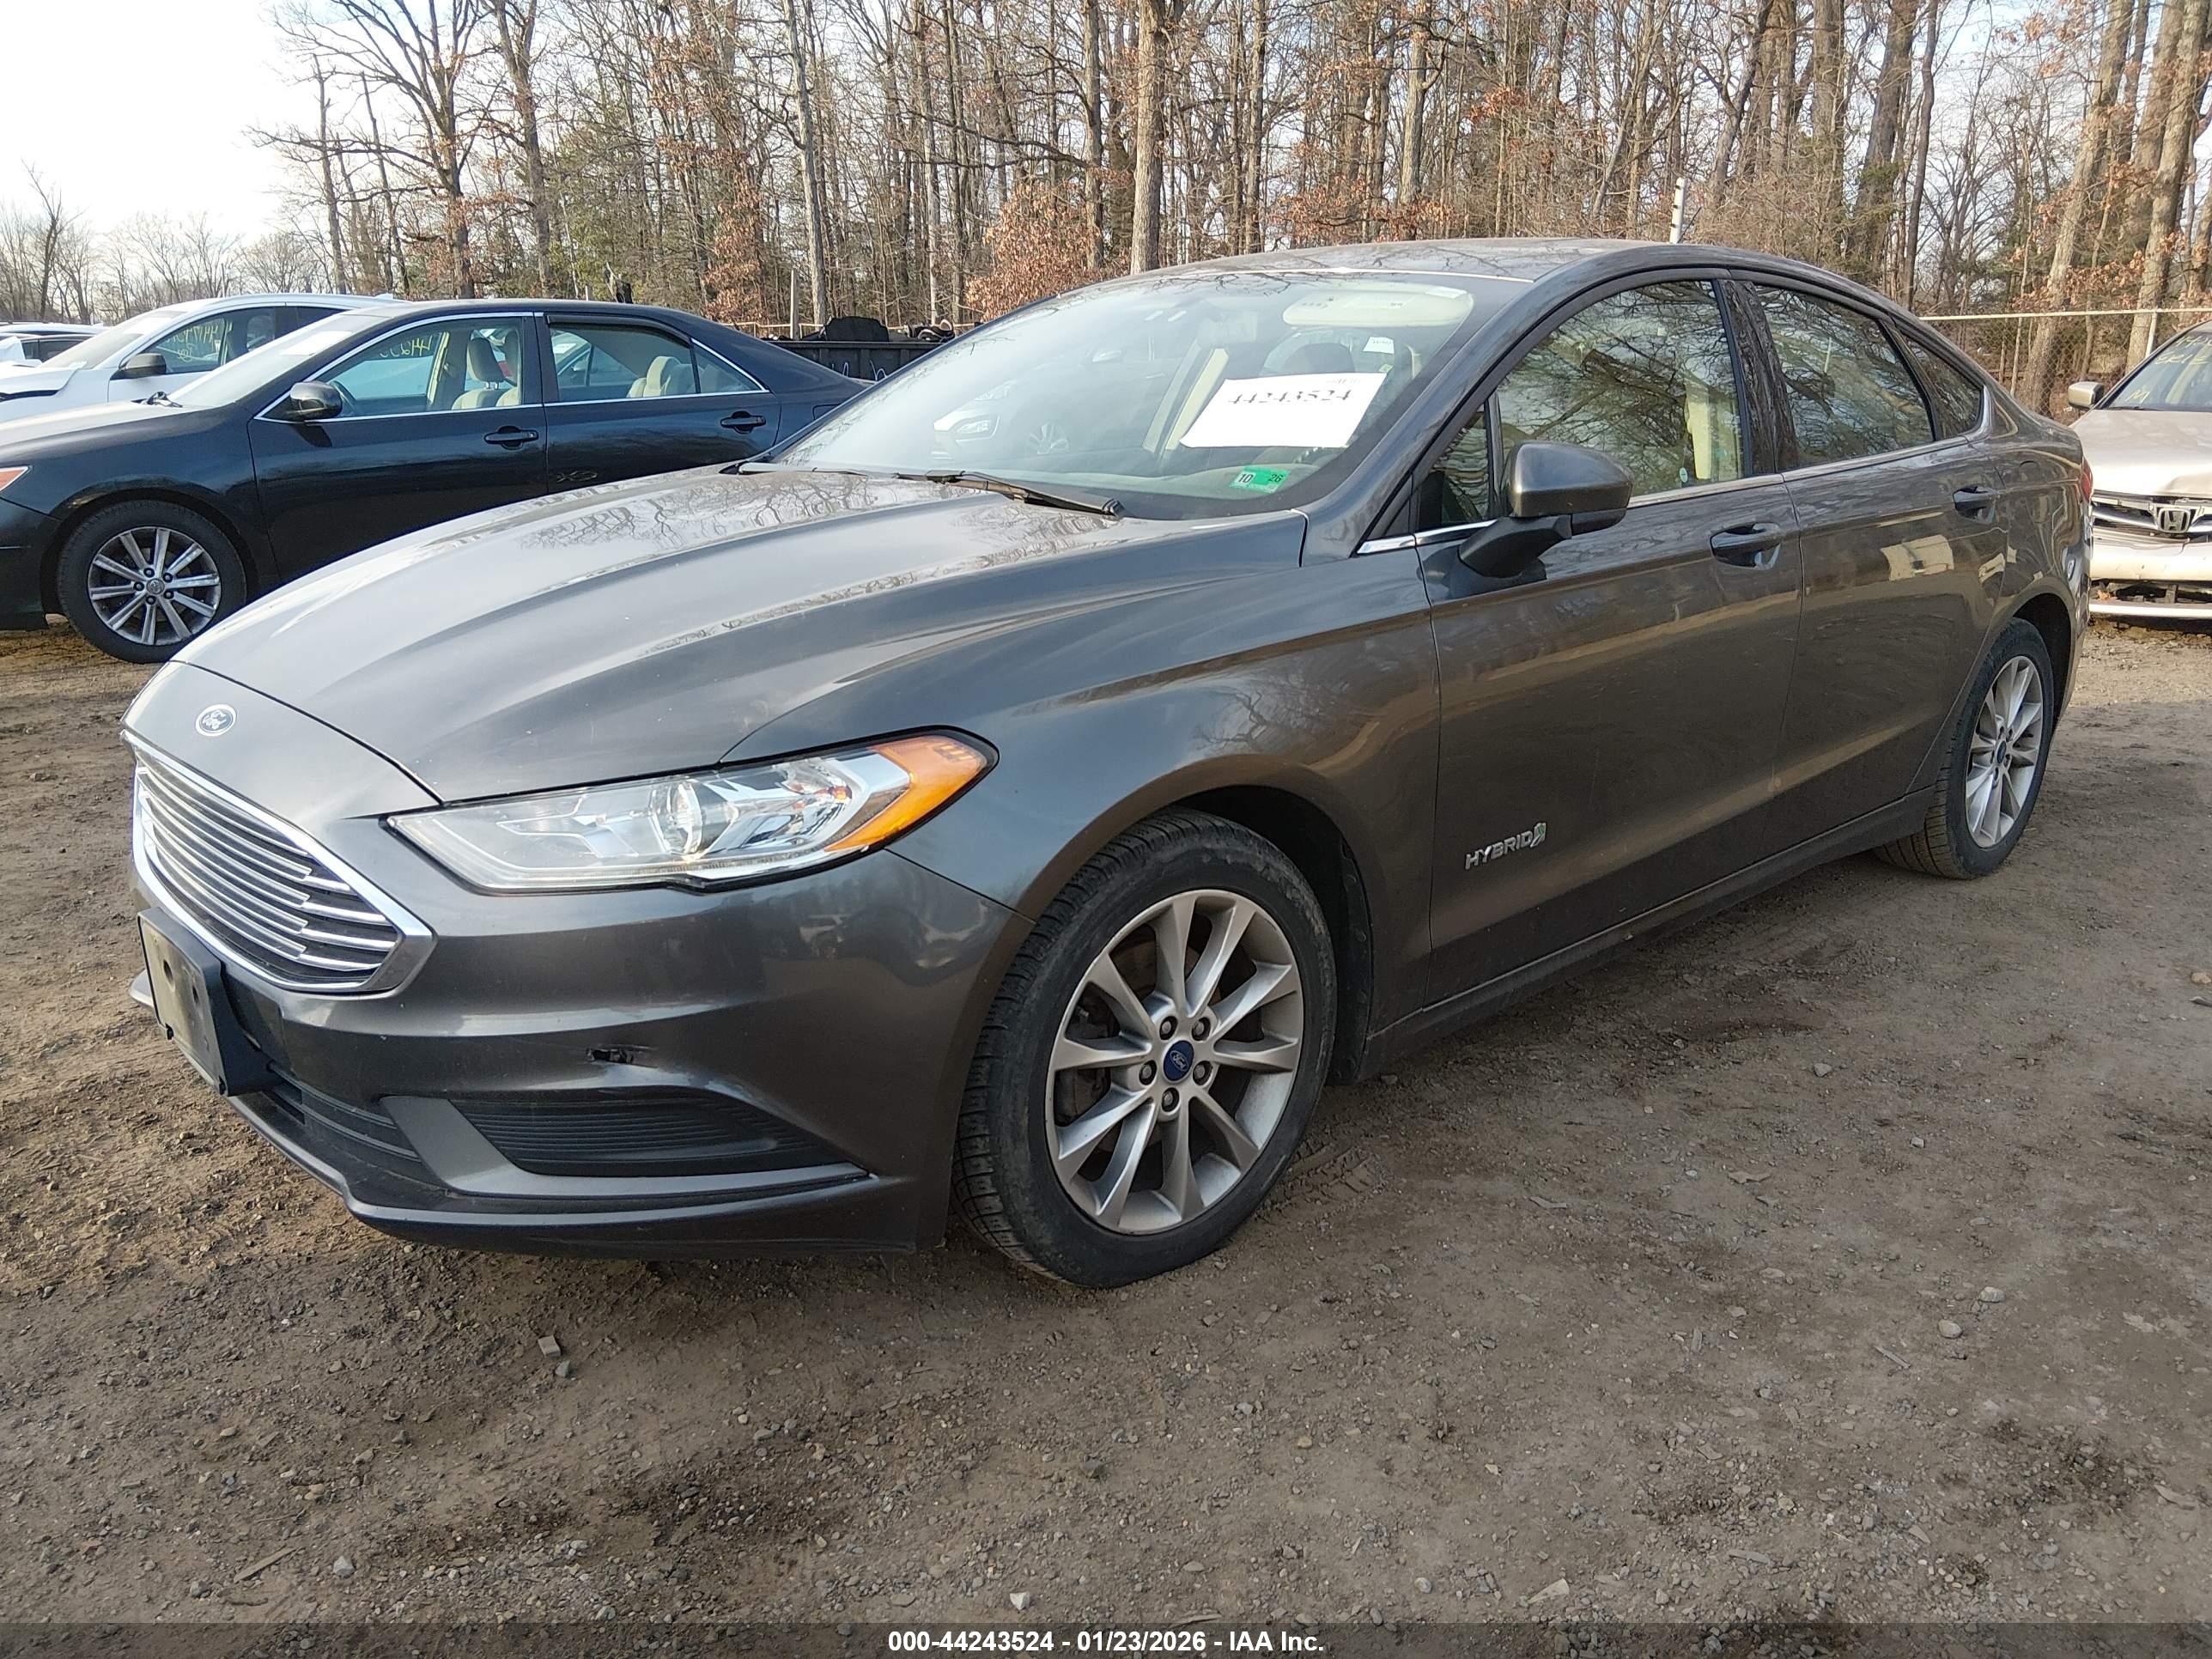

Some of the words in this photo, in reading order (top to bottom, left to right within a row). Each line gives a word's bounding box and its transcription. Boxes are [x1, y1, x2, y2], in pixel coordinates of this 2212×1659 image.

[1238, 473, 1254, 483] 10
[1268, 473, 1284, 483] 26
[1464, 830, 1533, 870] HYBRID
